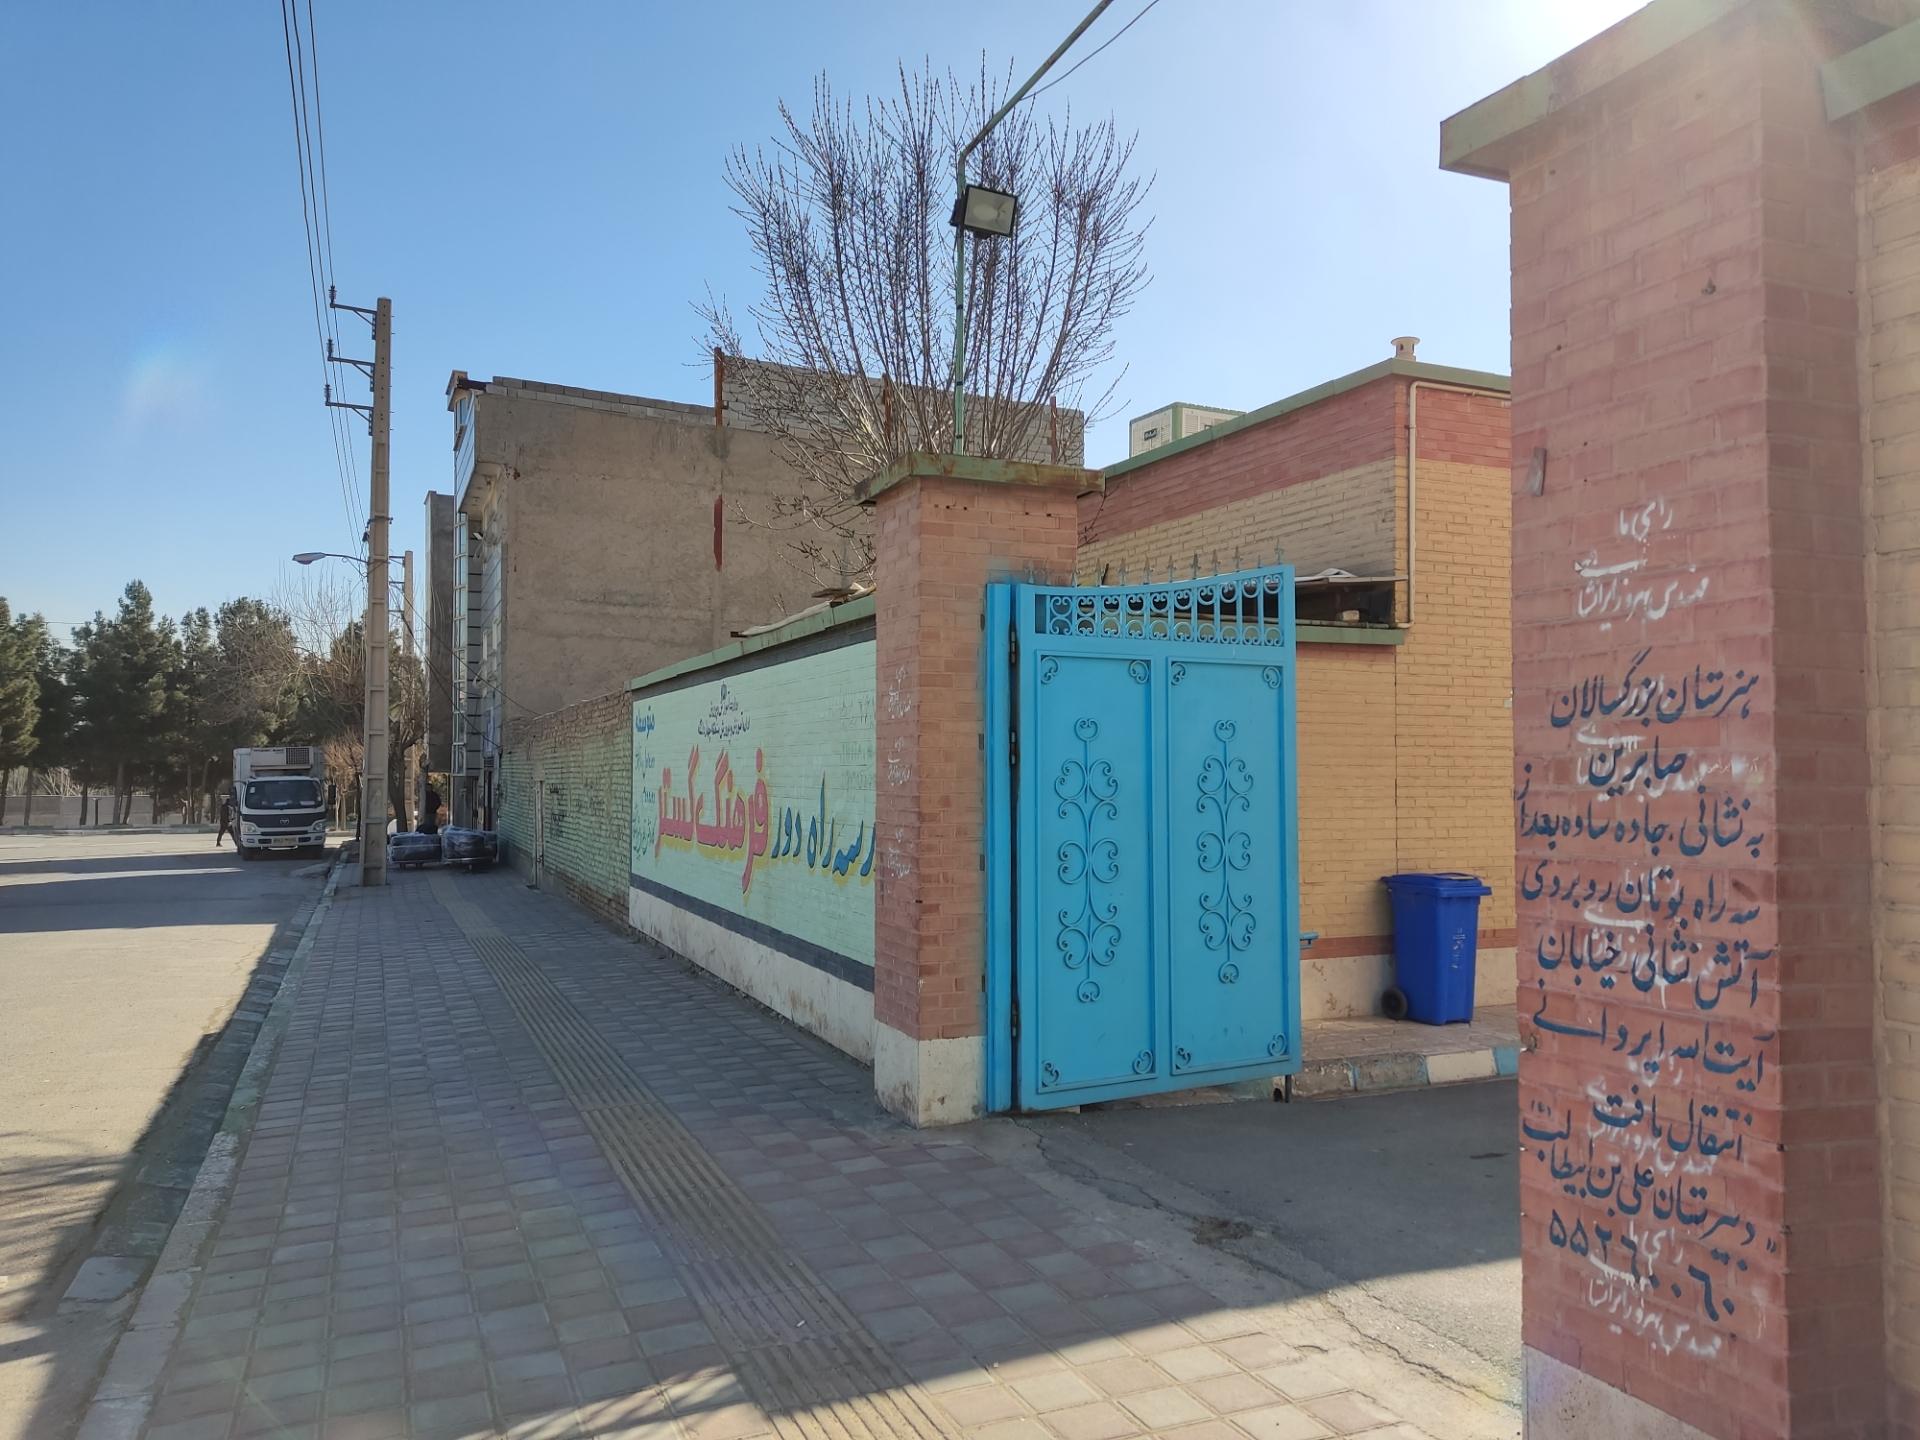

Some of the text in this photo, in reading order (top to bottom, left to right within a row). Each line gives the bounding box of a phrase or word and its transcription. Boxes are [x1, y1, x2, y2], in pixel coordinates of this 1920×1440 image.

[1550, 646, 1759, 728] هنرستان بزرگسالان
[1588, 736, 1688, 795] صابرین
[655, 744, 699, 859] گستر
[696, 746, 769, 895] فرهنگ
[771, 806, 802, 859] دور
[807, 770, 835, 869] راه
[1561, 800, 1611, 840] ساوه
[1614, 800, 1670, 856] جاده
[1679, 785, 1751, 856] نشانی
[1746, 832, 1764, 858] به
[1616, 866, 1688, 930] بوتان
[1693, 874, 1726, 923] راه
[1729, 905, 1761, 925] سه
[1537, 925, 1621, 990] خیابان
[1632, 923, 1700, 992] نشانی
[1694, 939, 1773, 1010] آتش
[1667, 1098, 1754, 1161] انتقال
[1586, 1162, 1622, 1217] بن
[1616, 1162, 1655, 1216] علی
[1652, 1175, 1757, 1272] دبیرستان
